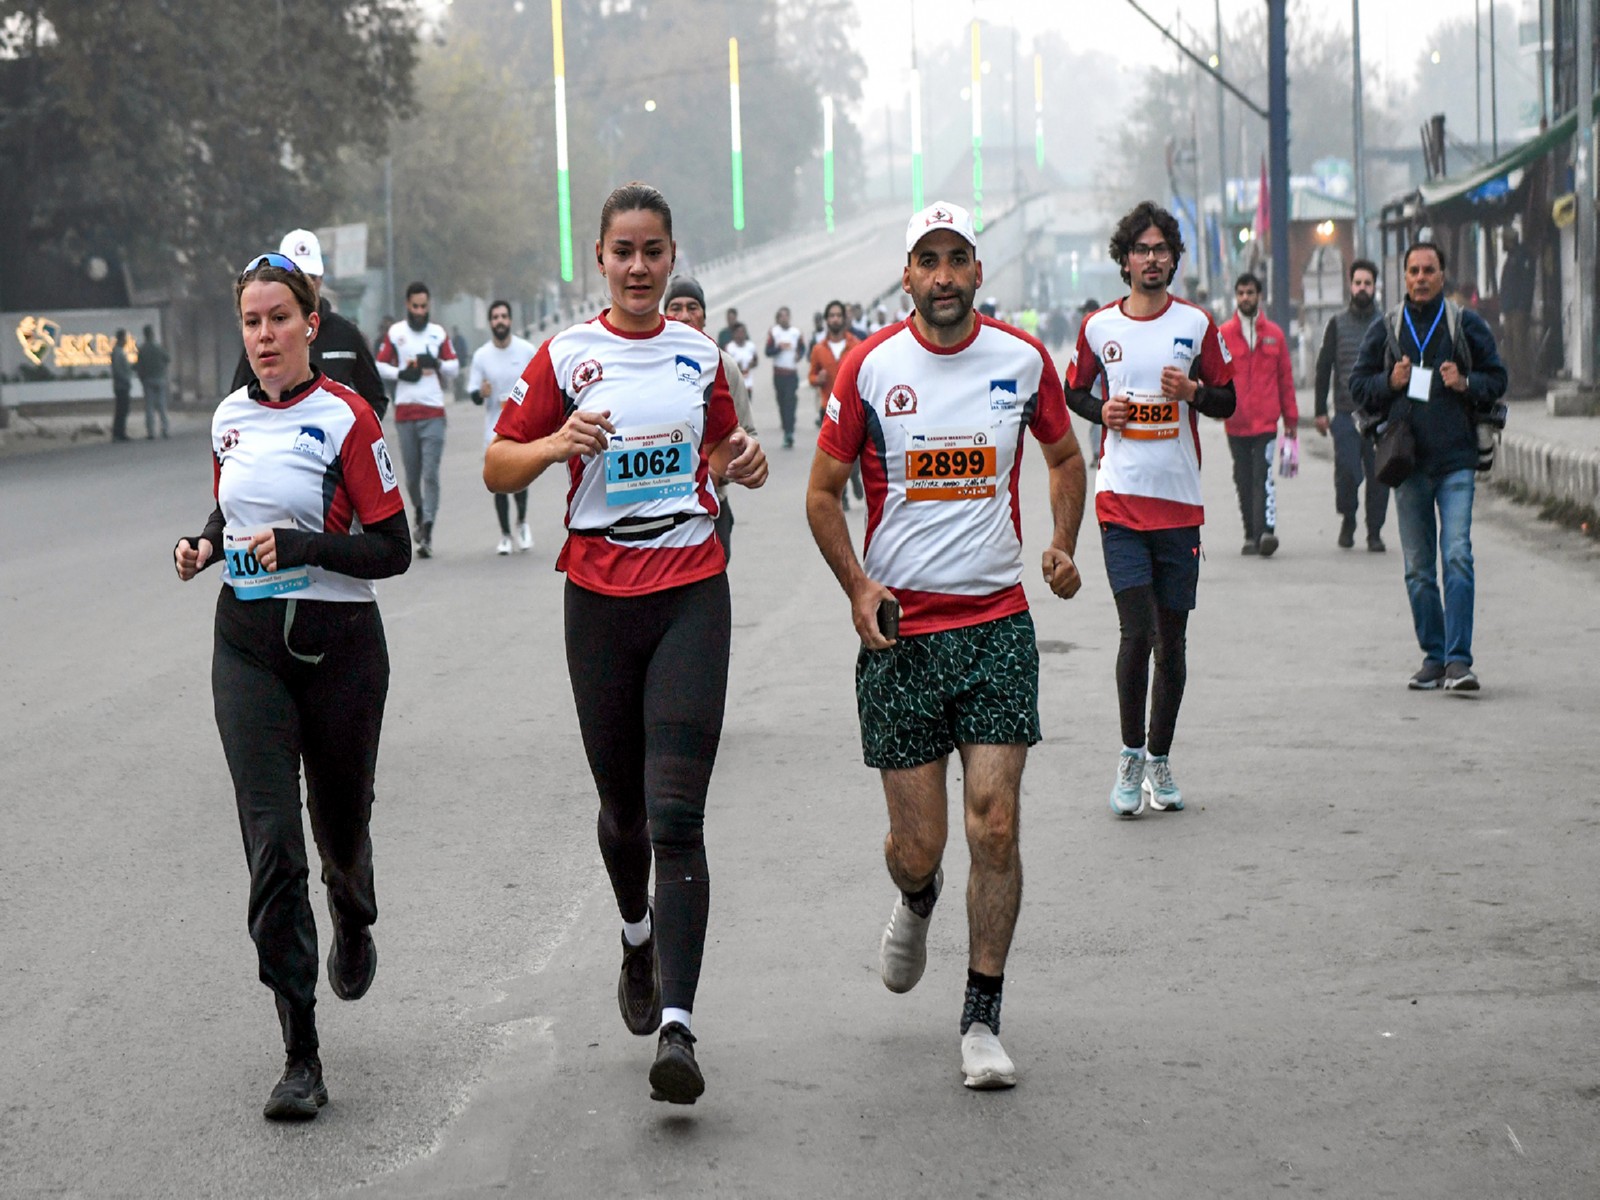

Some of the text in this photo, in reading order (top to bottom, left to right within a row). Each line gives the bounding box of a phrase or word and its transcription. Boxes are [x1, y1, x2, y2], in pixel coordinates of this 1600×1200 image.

[1129, 404, 1173, 422] 2582
[646, 432, 670, 440] MARATHON
[618, 447, 680, 480] 1062
[917, 450, 985, 477] 2899
